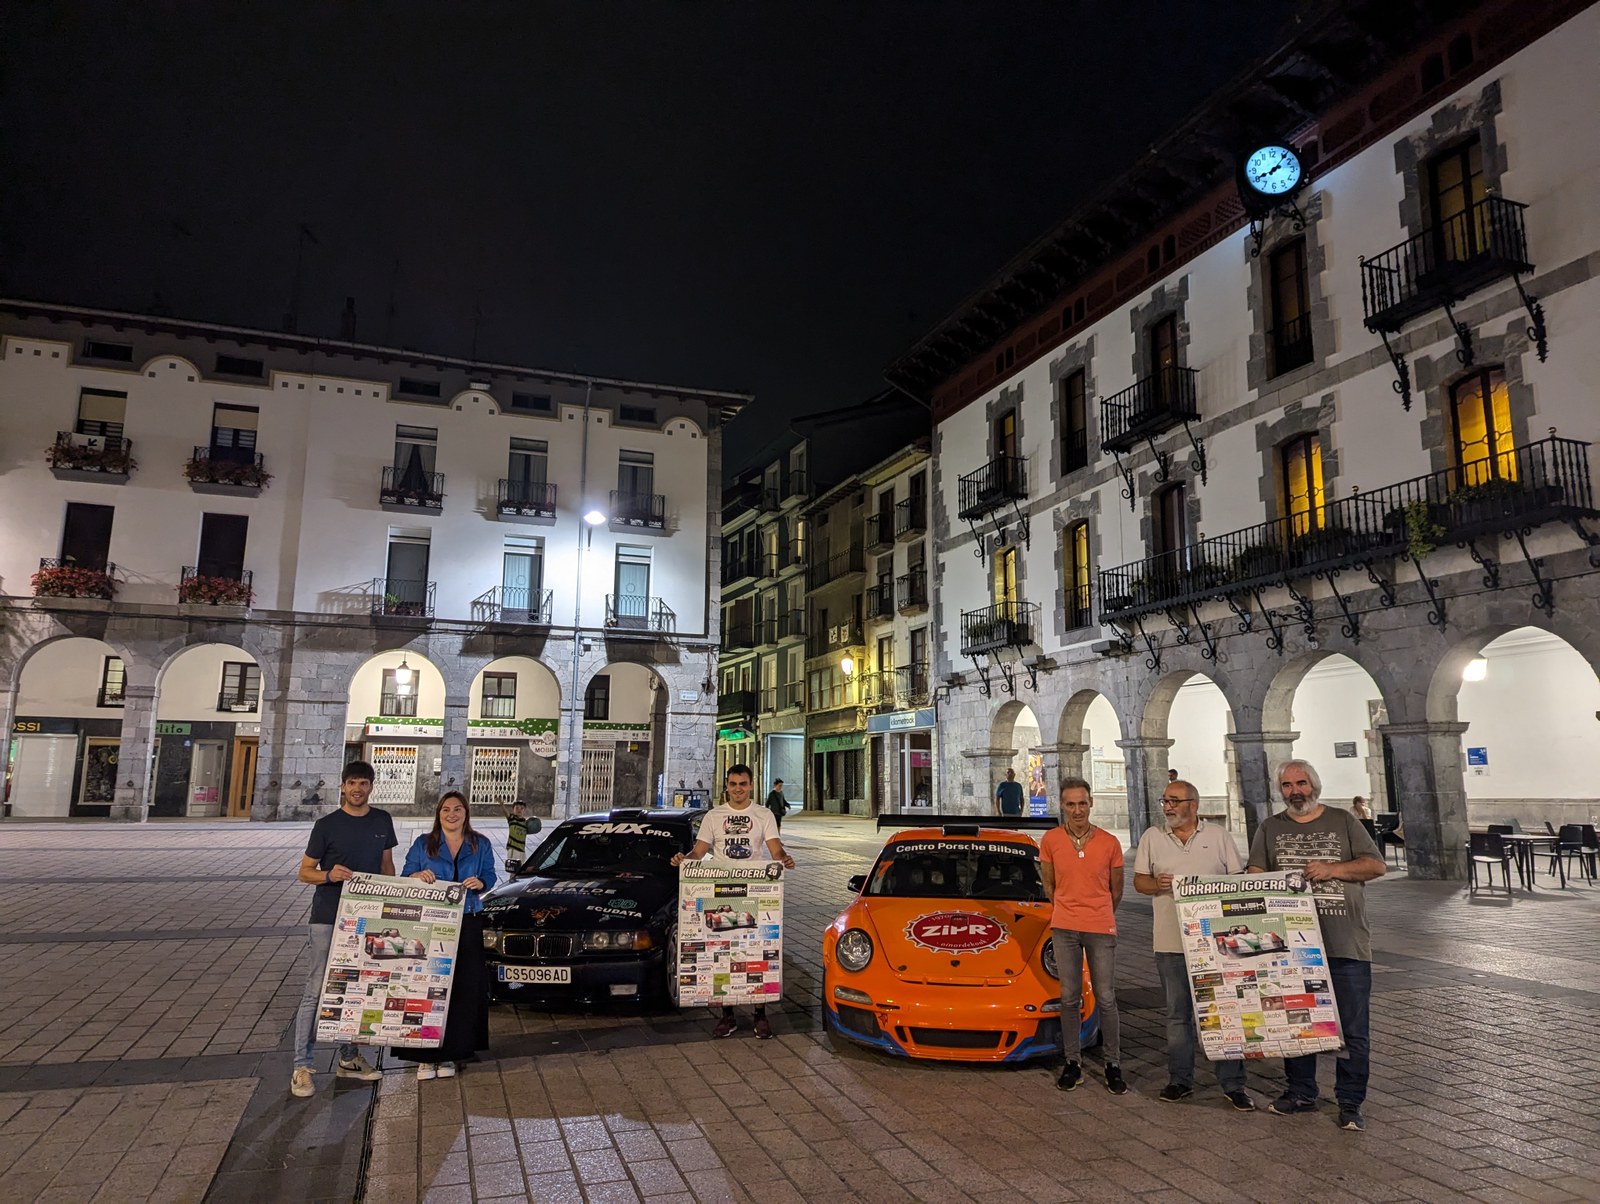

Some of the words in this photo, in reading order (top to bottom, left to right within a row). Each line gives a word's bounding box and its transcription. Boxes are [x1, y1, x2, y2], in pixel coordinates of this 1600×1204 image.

[1290, 165, 1295, 173] 3
[1255, 175, 1260, 183] 8
[156, 723, 183, 734] lito
[727, 815, 751, 824] HARD
[577, 822, 652, 835] SMX
[645, 829, 671, 837] PRO
[724, 837, 750, 846] KILLER
[896, 843, 935, 853] Centro
[938, 843, 986, 851] Porsche
[989, 844, 1026, 856] Bilbao
[732, 868, 767, 879] IGOERA
[1241, 880, 1287, 891] IGOERA
[1289, 878, 1302, 888] 20
[406, 887, 447, 901] IGOERA
[448, 890, 460, 900] 20
[586, 905, 643, 918] ECUDATA
[505, 967, 568, 982] CS5096AD
